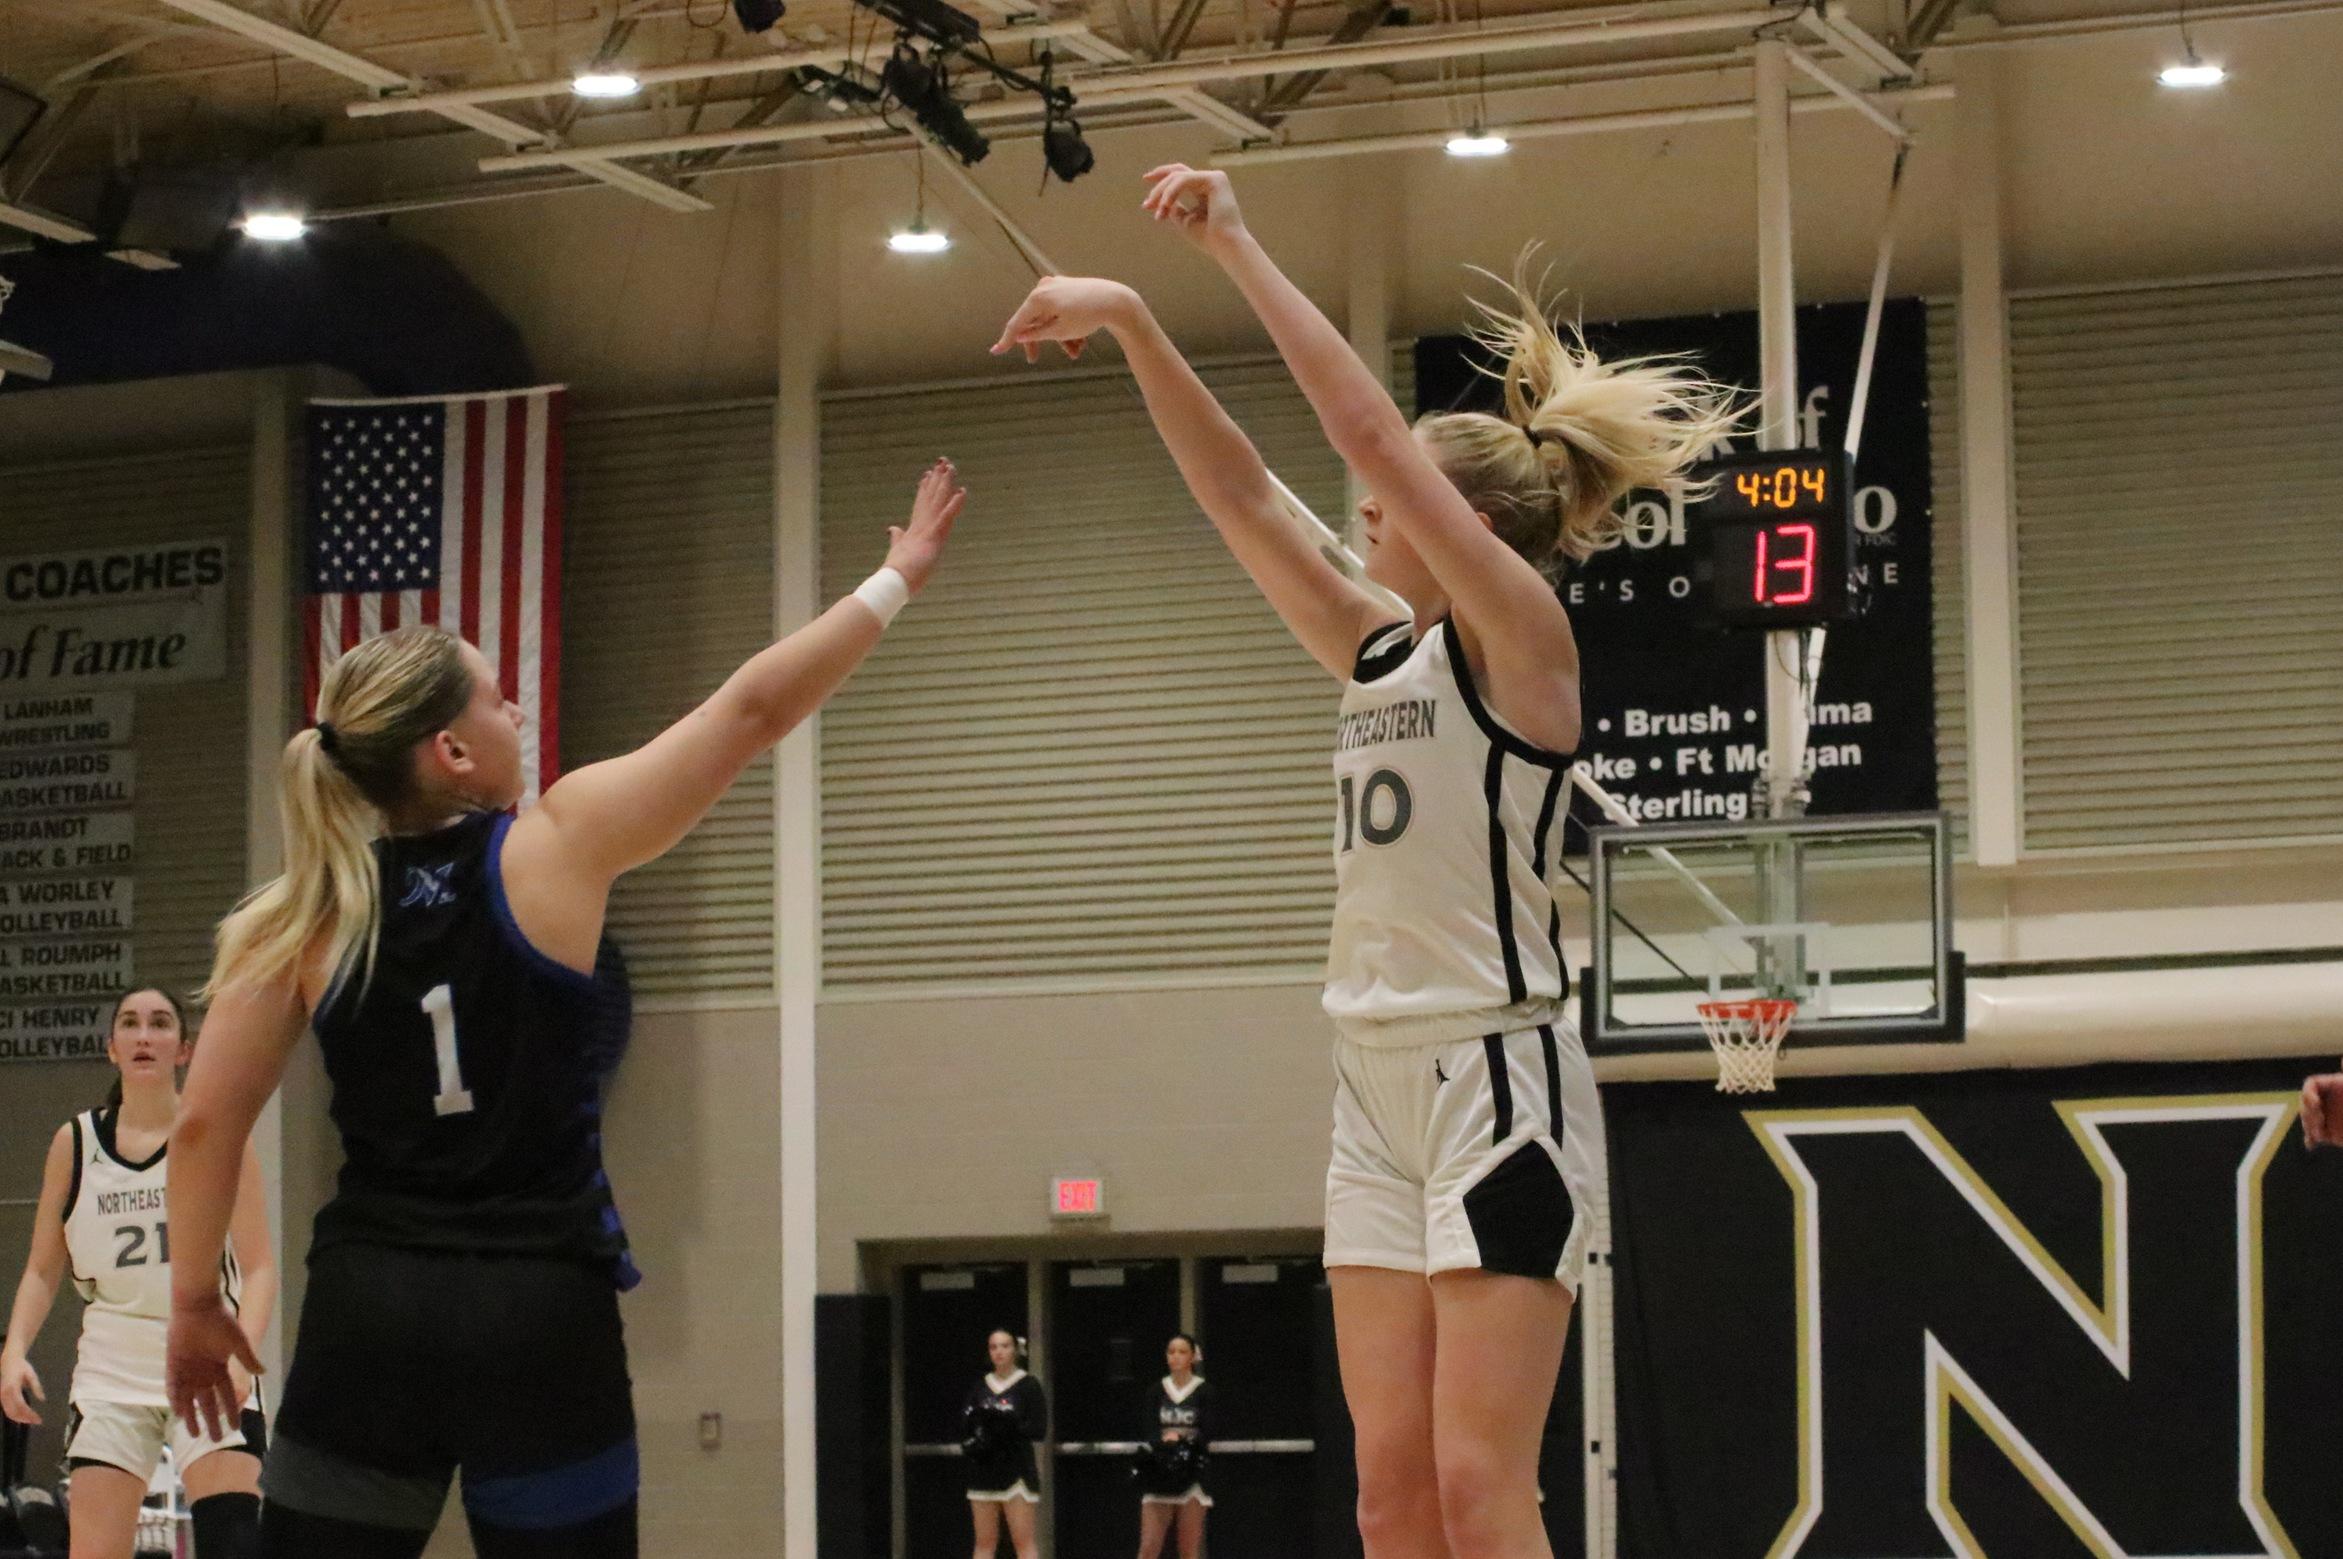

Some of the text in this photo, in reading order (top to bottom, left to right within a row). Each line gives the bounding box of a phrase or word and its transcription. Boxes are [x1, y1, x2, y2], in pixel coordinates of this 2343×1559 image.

[1737, 467, 1825, 508] 4:04
[5, 547, 224, 601] COACHES
[1754, 523, 1816, 605] 13
[50, 628, 187, 677] Fame
[1625, 704, 1731, 737] Brush
[1676, 748, 1714, 775] Ft
[0, 782, 127, 807] ASKETBALL
[1340, 768, 1414, 853] 10
[0, 850, 42, 868] ACK
[76, 844, 131, 866] FIELD
[19, 880, 115, 904] WORLEY
[0, 909, 123, 934] OLLEYBALL
[22, 942, 121, 966] ROUMPH
[0, 972, 126, 995] ASKETBALL
[22, 1007, 98, 1028] HENRY
[421, 983, 475, 1116] 1
[1059, 1181, 1097, 1212] EXIT
[114, 1221, 170, 1269] 21
[1741, 1091, 2301, 1559] N
